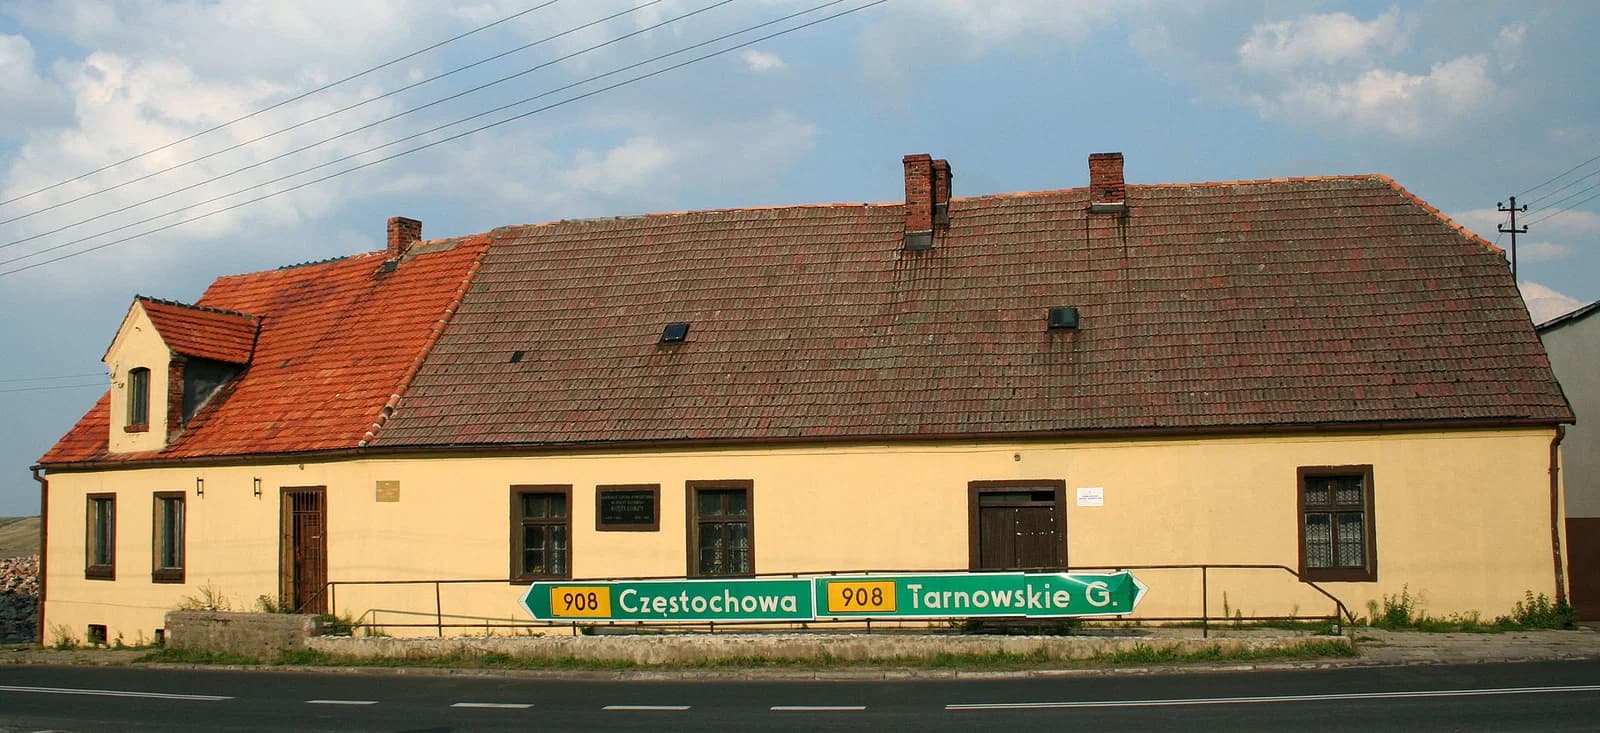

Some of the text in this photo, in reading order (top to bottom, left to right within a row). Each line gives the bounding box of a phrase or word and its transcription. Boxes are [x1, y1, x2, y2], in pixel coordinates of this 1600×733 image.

[563, 588, 798, 617] 908 Częstochowa
[841, 581, 1118, 609] 908 Tarnowskie G.
